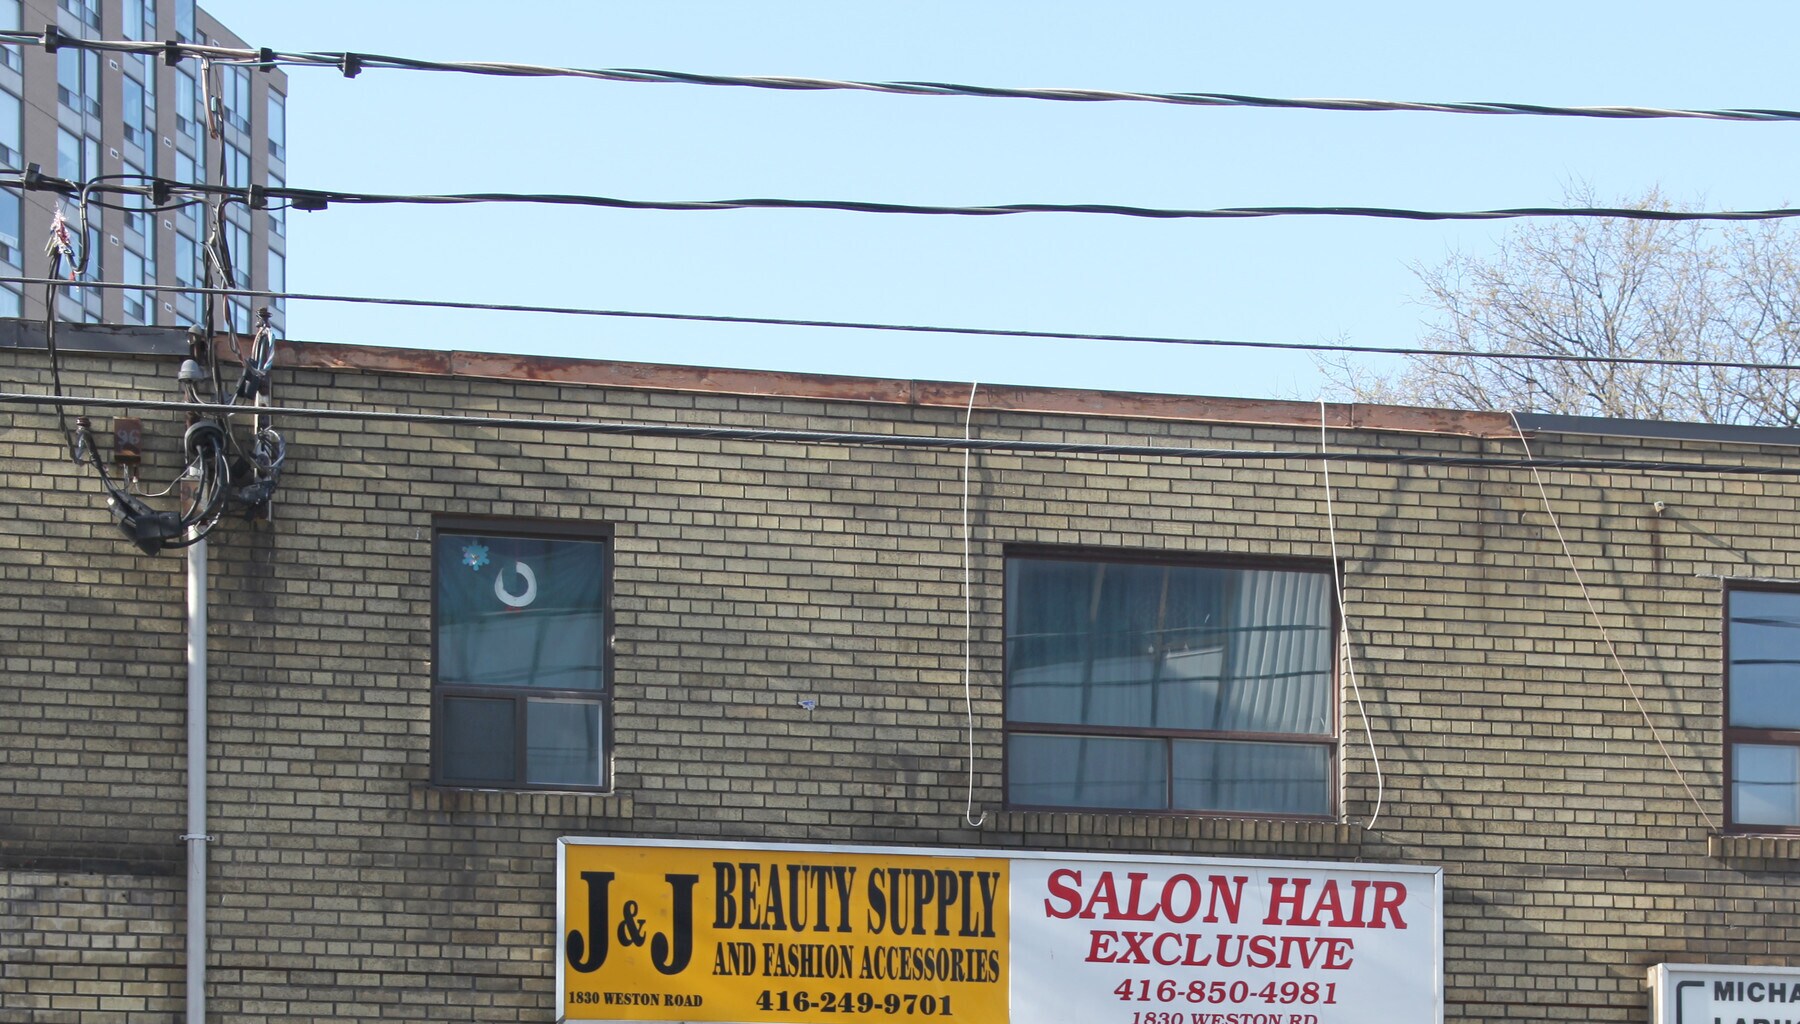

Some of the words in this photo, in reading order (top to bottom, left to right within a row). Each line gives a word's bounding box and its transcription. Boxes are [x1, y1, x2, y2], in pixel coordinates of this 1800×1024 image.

[712, 862, 857, 933] BEAUTY
[867, 867, 1000, 938] SUPPLY
[1044, 868, 1249, 924] SALON
[1262, 877, 1408, 930] HAIR
[712, 942, 756, 976] AND
[762, 942, 854, 979] FASHION
[860, 945, 1000, 983] ACCESSORIES
[1084, 929, 1355, 970] EXCLUSIVE
[568, 991, 600, 1005] 1830
[603, 992, 660, 1007] WESTON
[664, 994, 703, 1008] ROAD
[756, 990, 954, 1016] 416-249-9701
[1113, 978, 1338, 1005] 416-850-4981
